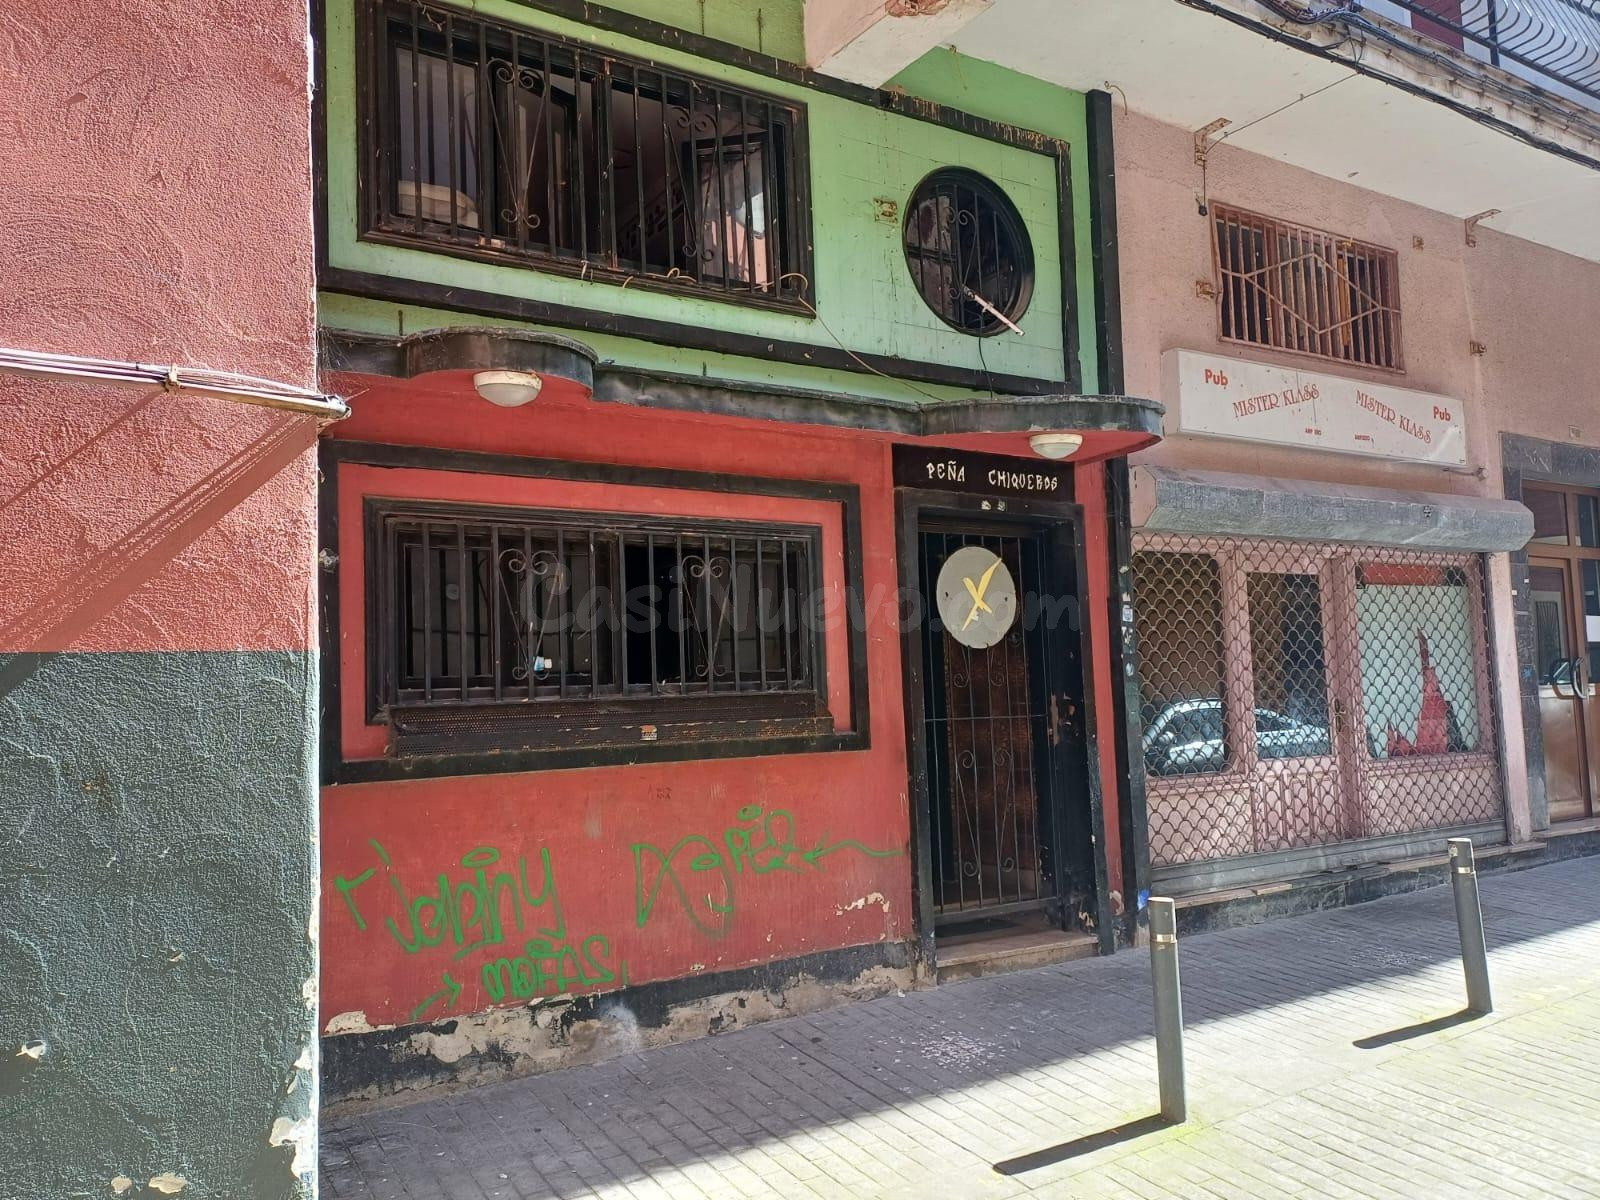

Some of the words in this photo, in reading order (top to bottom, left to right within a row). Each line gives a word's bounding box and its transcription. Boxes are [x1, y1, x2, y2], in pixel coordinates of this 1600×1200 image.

[1204, 368, 1229, 386] Pub
[1232, 392, 1280, 418] MISTER
[1280, 383, 1320, 408] KLASS
[1433, 405, 1451, 422] Pub
[1355, 390, 1397, 422] MISTER
[1399, 414, 1432, 444] KLASS
[926, 460, 965, 483] PEÑA
[988, 469, 1059, 492] CHIQUEROS
